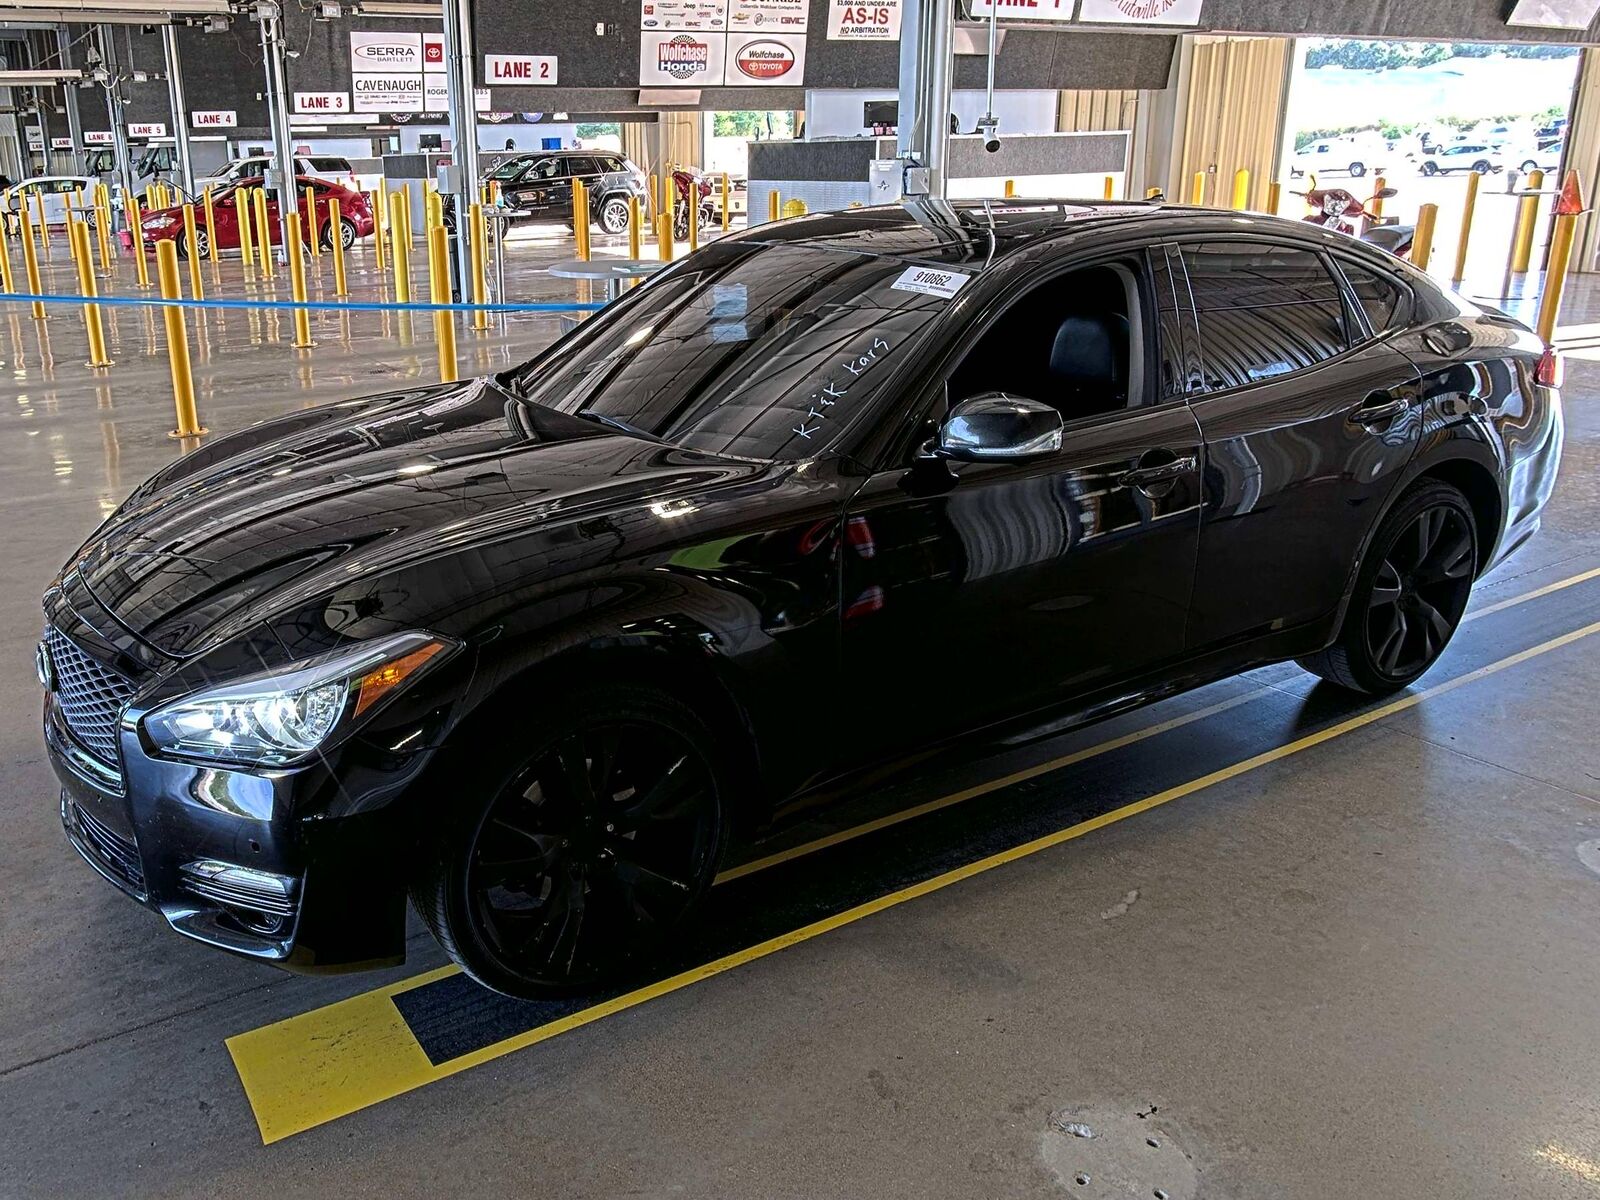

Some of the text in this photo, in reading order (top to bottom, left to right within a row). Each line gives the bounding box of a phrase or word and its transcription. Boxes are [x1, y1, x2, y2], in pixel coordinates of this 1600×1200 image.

[842, 7, 889, 24] AS-IS
[367, 47, 415, 56] SERRA
[660, 43, 707, 61] Wolfchase
[749, 50, 785, 59] Wolfchase
[494, 61, 549, 78] LANE 2
[661, 60, 706, 71] Honda
[355, 79, 421, 91] CAVENAUGH
[301, 97, 343, 108] LANE 3
[198, 115, 231, 124] LANE 4
[133, 126, 161, 134] LANE 5
[912, 271, 952, 287] 910862
